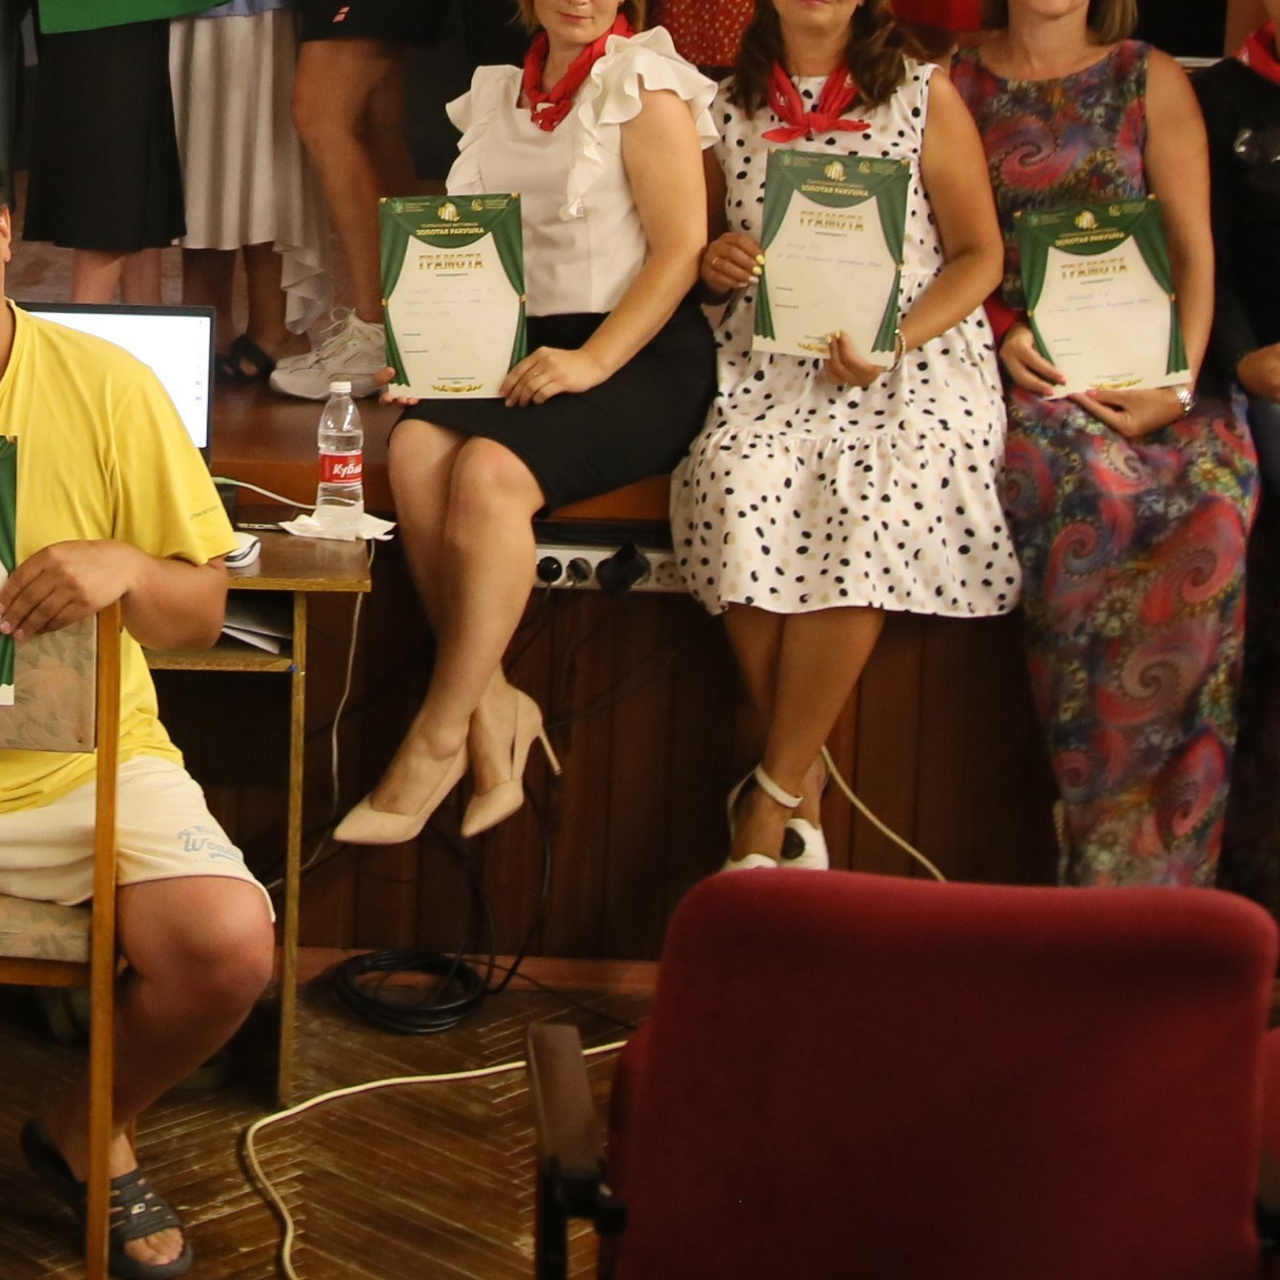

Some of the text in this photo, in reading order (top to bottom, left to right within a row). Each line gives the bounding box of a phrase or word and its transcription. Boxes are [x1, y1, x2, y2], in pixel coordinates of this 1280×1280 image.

[800, 210, 864, 231] ГРАМОТА
[418, 252, 484, 270] ГРАМОТА
[1060, 257, 1127, 279] ГРАМОТА
